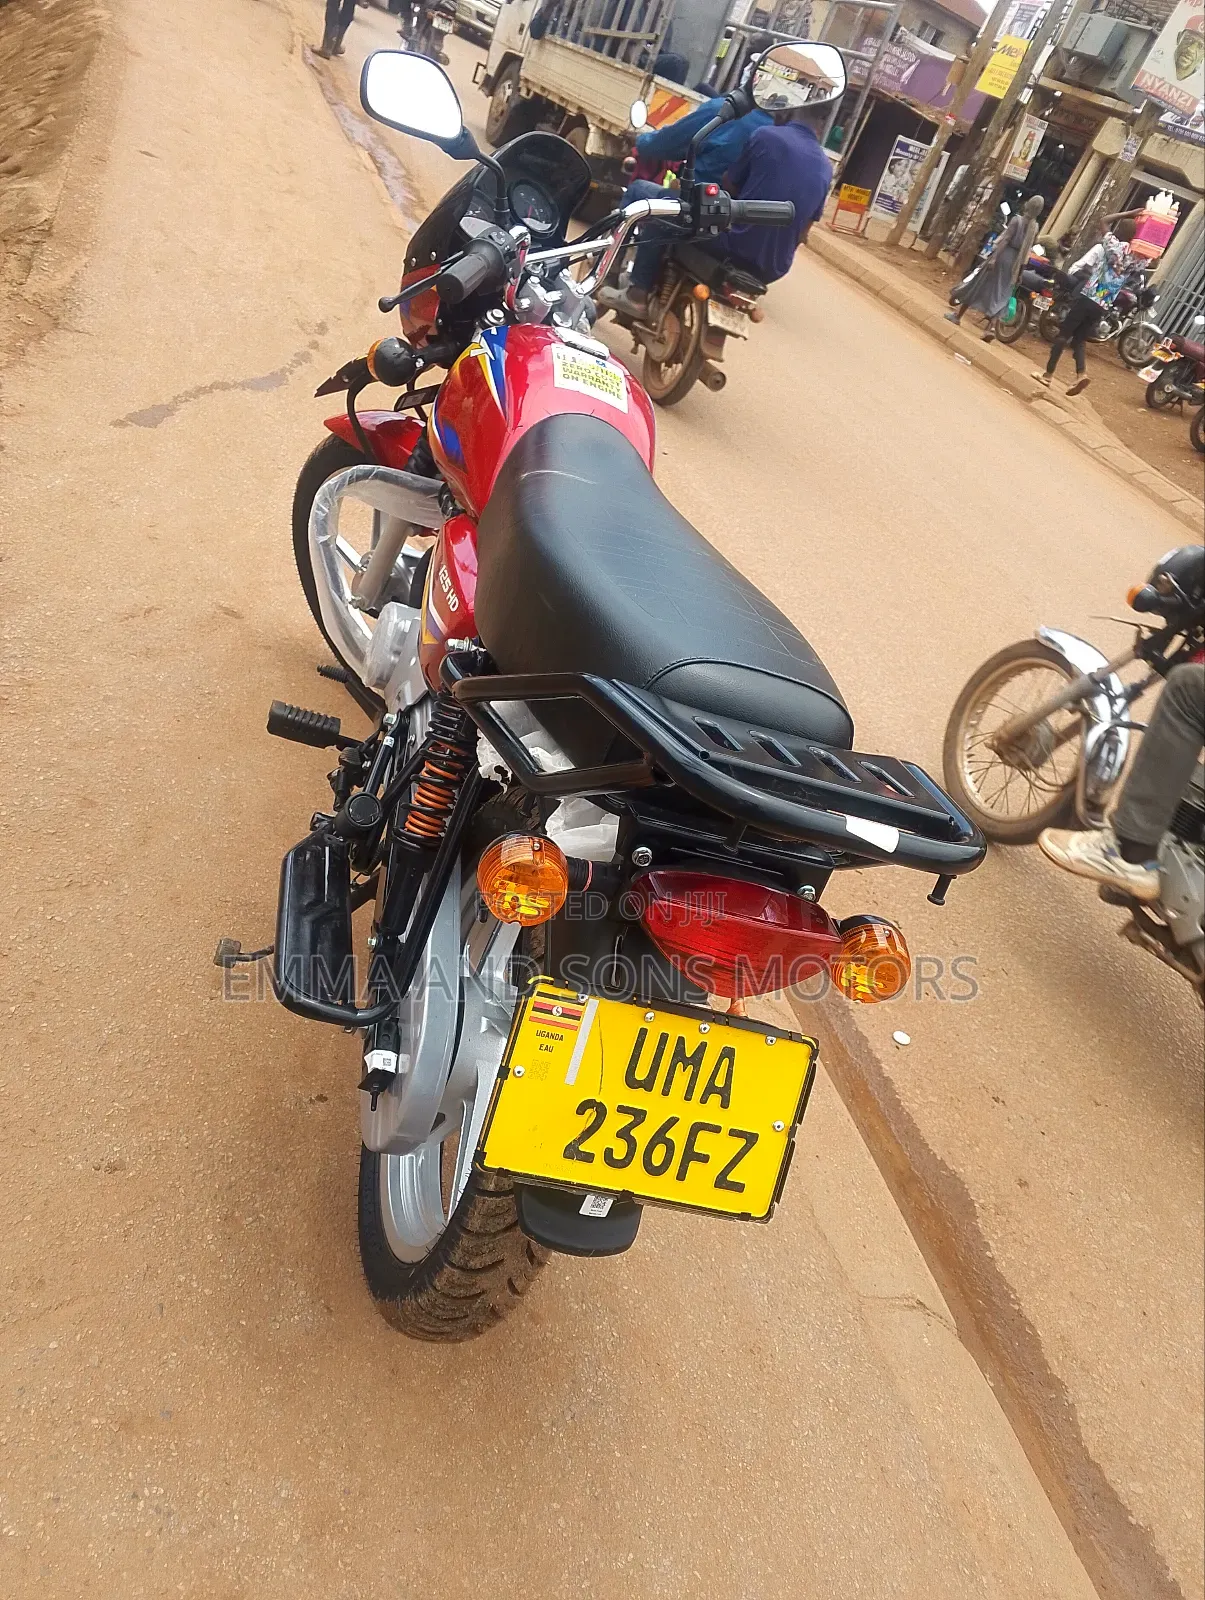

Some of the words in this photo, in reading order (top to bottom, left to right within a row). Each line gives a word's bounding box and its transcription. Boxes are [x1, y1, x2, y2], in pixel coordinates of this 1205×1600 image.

[1141, 72, 1193, 107] NYANZI
[562, 361, 591, 374] ZERO
[594, 372, 619, 387] COST
[562, 367, 621, 393] WARRANTY
[562, 373, 579, 382] ON
[582, 379, 623, 400] ENGINE
[438, 564, 452, 593] 125
[446, 588, 459, 612] HD
[535, 1029, 564, 1042] UGANDA
[539, 1044, 554, 1054] EAU
[624, 1027, 737, 1109] UMA
[562, 1098, 759, 1193] 236FZ
